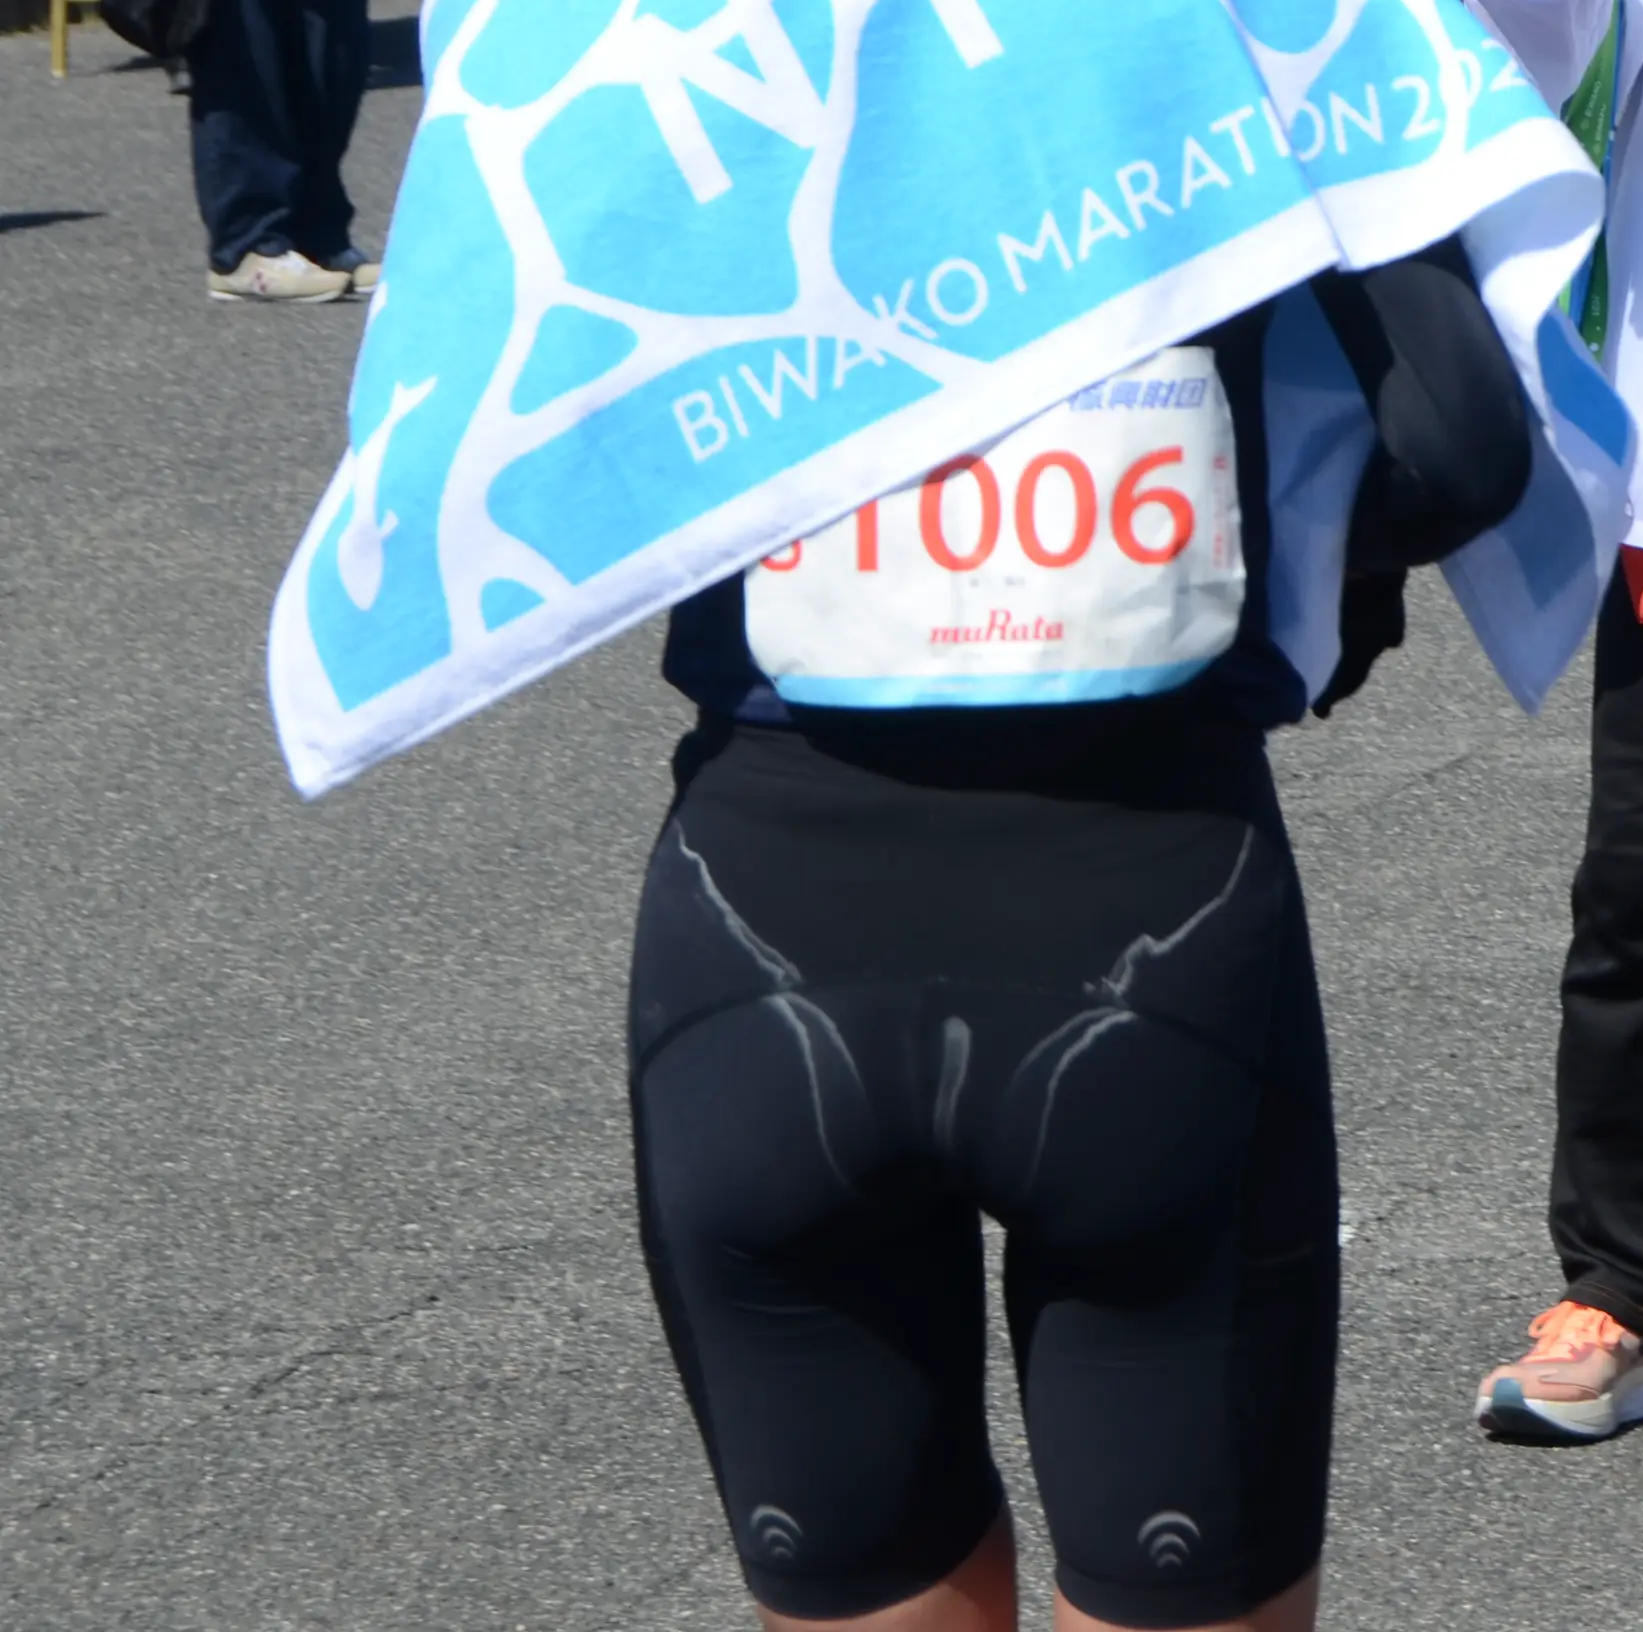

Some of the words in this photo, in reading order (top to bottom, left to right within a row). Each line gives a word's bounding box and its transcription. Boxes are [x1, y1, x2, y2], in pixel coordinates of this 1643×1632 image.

[671, 257, 988, 461] BIWAKO
[1391, 37, 1530, 142] 202
[930, 608, 1064, 644] muRata
